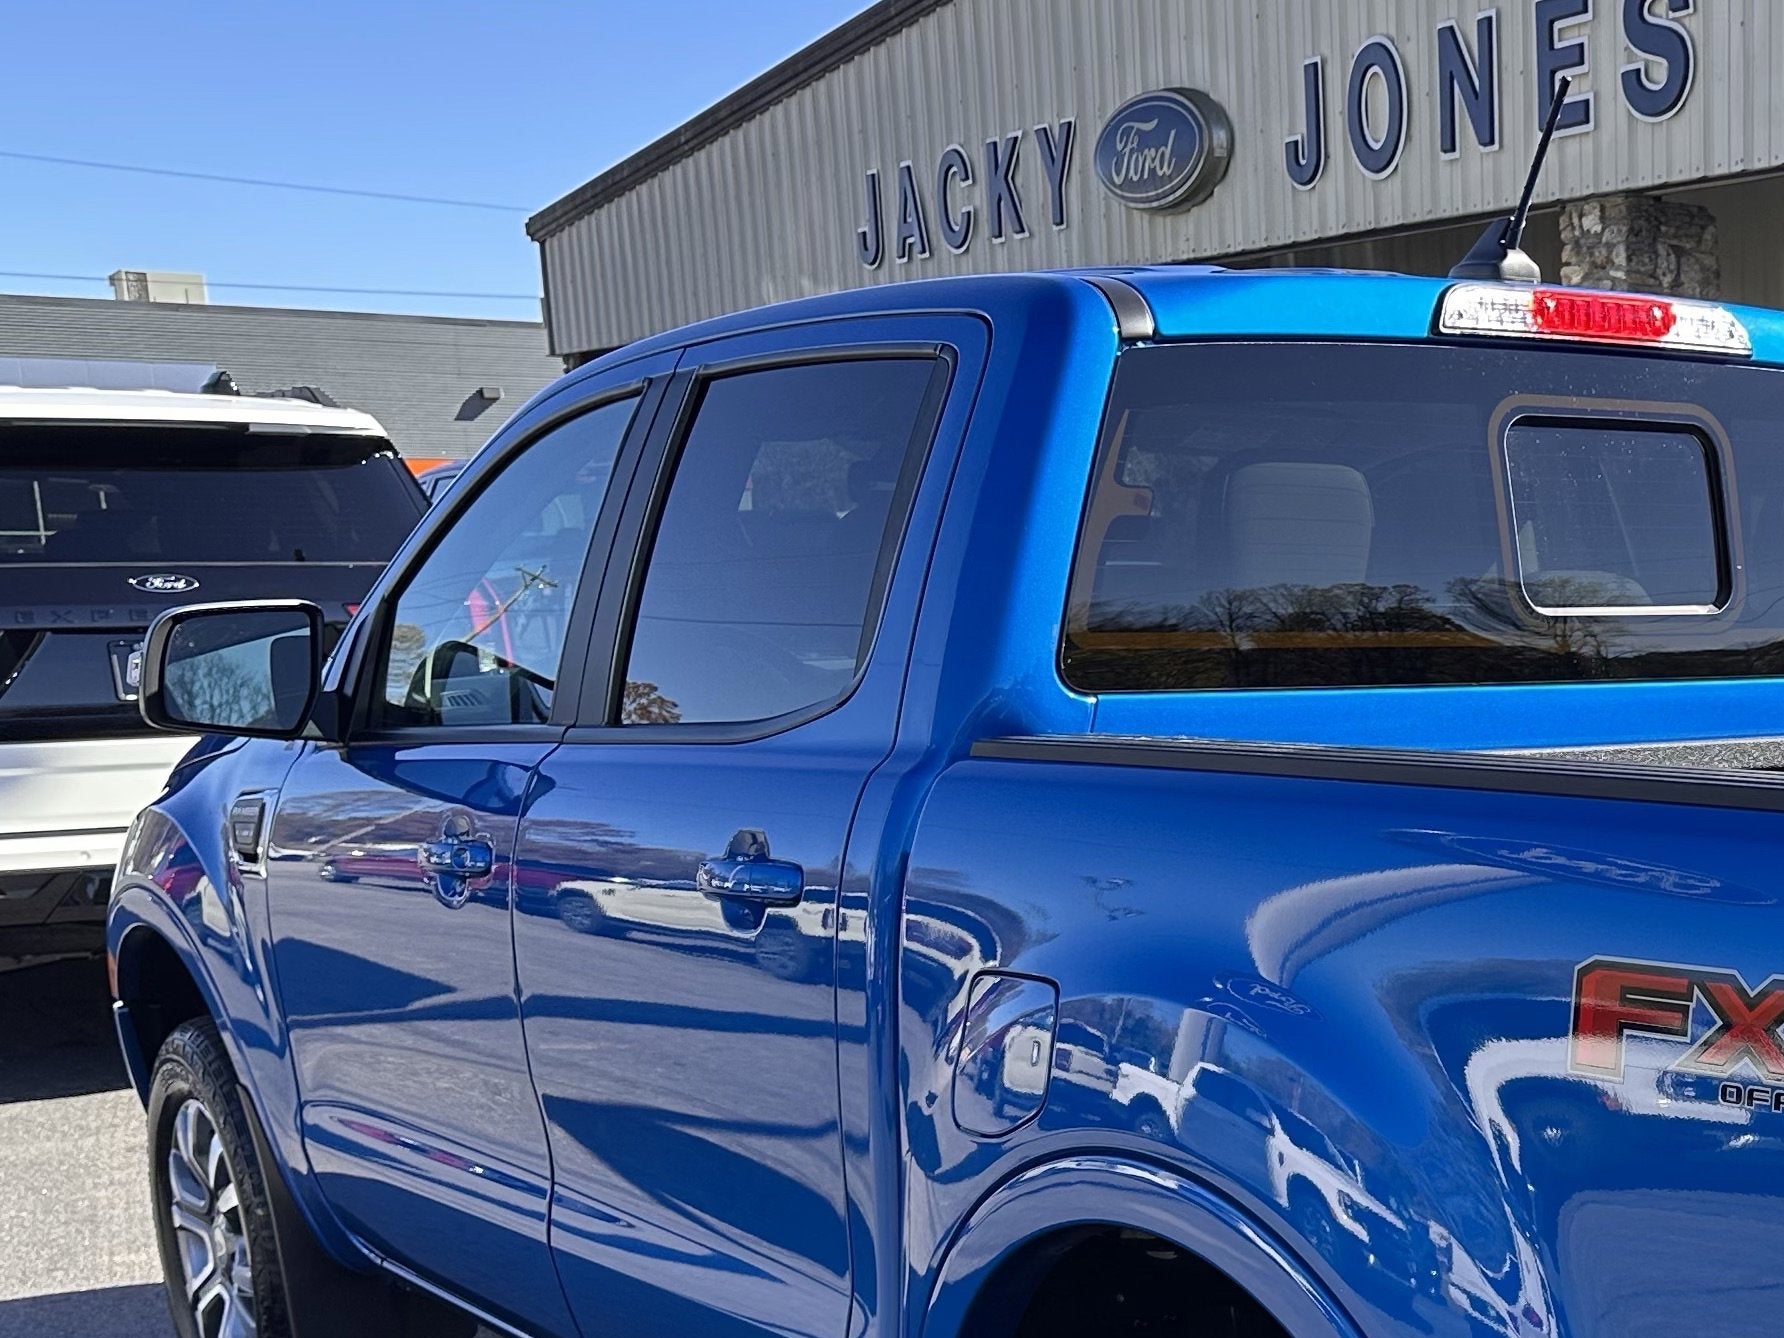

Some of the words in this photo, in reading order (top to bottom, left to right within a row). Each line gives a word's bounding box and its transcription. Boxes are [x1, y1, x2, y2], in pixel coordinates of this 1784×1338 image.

[857, 117, 1075, 269] JACKY
[1112, 118, 1177, 186] Ford
[1285, 0, 1694, 190] JONES
